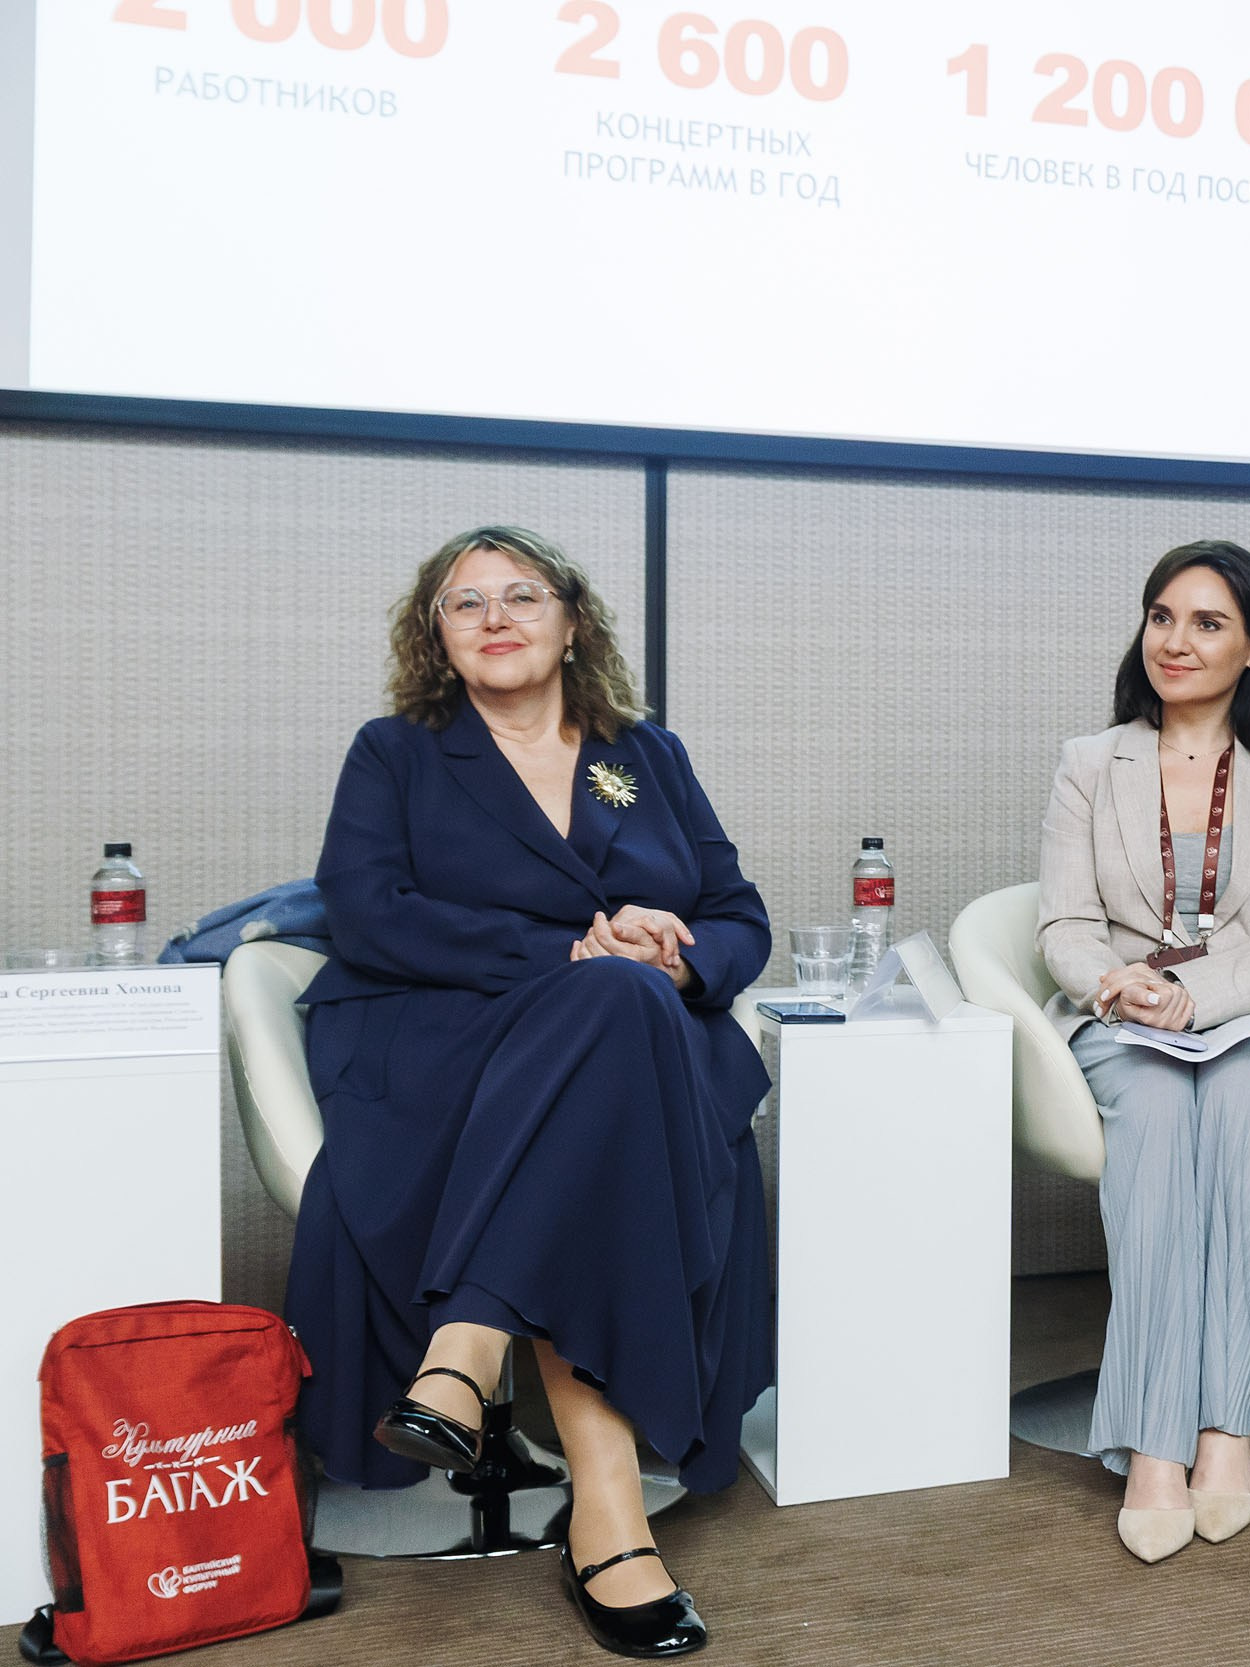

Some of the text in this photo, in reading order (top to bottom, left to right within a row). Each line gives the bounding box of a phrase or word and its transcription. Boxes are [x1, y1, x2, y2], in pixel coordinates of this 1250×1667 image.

[554, 0, 849, 102] 2 600
[155, 66, 398, 118] РАБОТНИКОВ
[945, 43, 989, 118] 1
[1030, 52, 1205, 139] 200
[596, 111, 812, 157] КОНЦЕРТНЫХ
[563, 150, 841, 208] ПРОГРАММ В ГОД
[966, 152, 1093, 187] ЧЕЛОВЕК
[1106, 164, 1121, 189] В
[1133, 168, 1186, 203] ГОД
[16, 985, 109, 1000] Сергеевна
[116, 983, 182, 994] Хомова
[102, 1418, 258, 1468] Культурный
[105, 1456, 270, 1524] БАГАЖ
